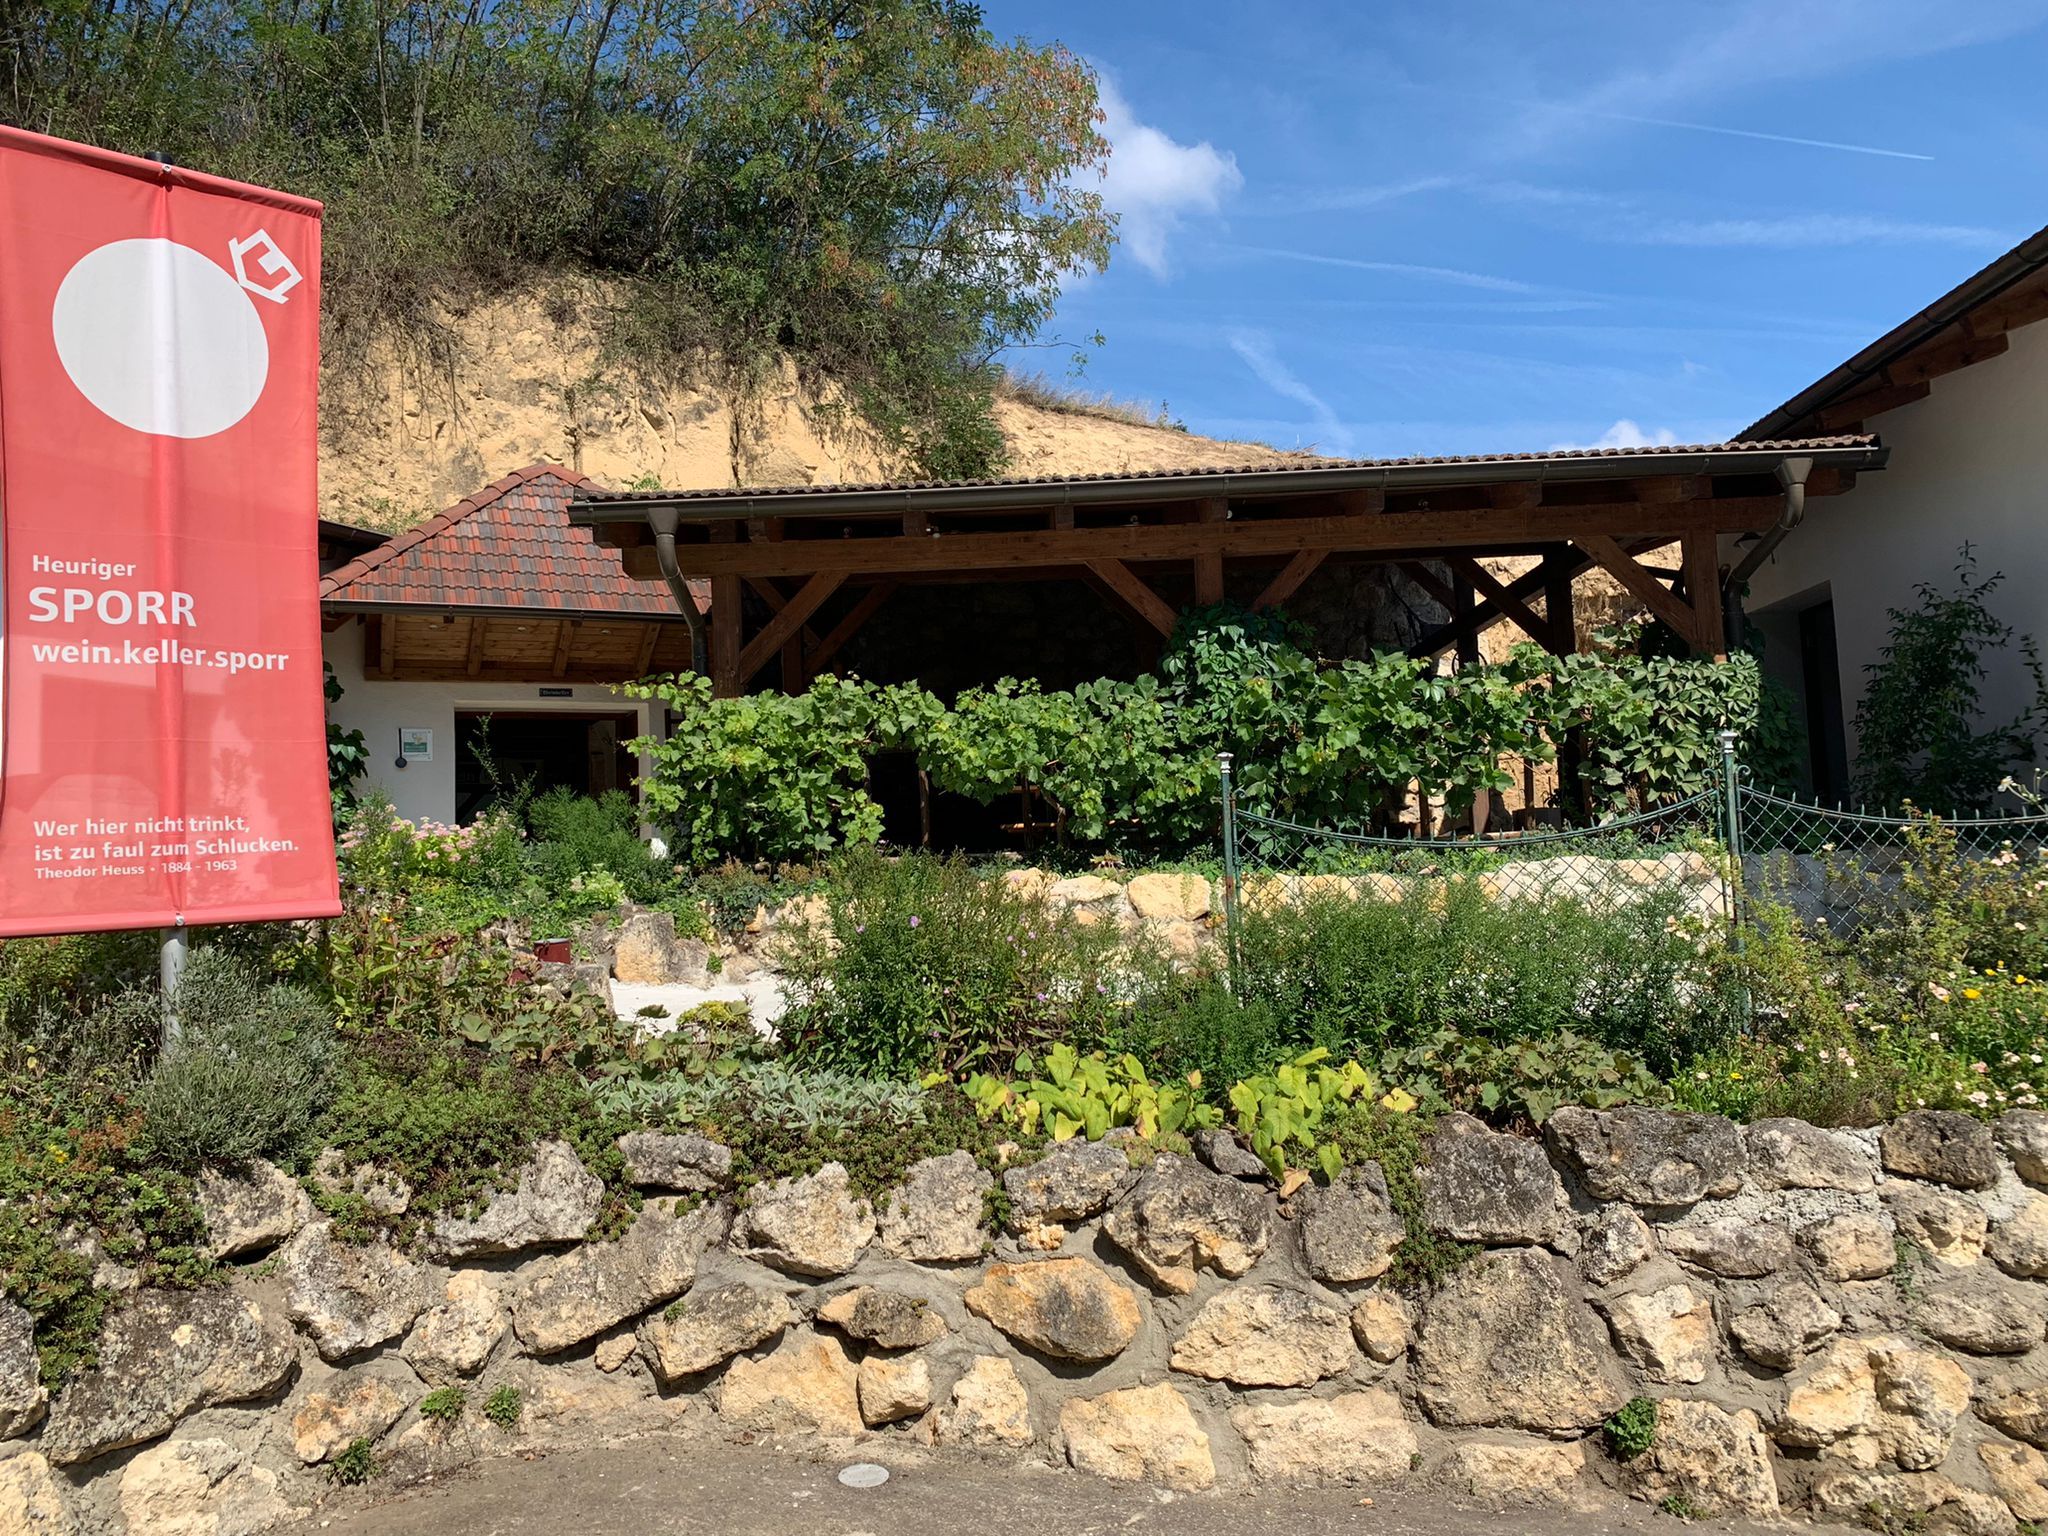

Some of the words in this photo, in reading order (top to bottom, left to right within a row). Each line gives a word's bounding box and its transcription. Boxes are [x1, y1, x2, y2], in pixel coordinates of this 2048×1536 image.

[32, 555, 136, 580] Heuriger
[28, 586, 197, 627] SPORR
[32, 639, 289, 674] wein.keller.sporr
[34, 820, 78, 837] Wer
[86, 819, 128, 835] hier
[135, 816, 184, 833] nicht
[189, 816, 250, 833] trinkt,
[34, 845, 63, 861] ist
[70, 847, 95, 859] zu
[102, 842, 144, 858] faul
[151, 844, 189, 857] zum
[195, 838, 299, 855] Schlucken.
[34, 865, 97, 879] Theodor
[102, 864, 145, 876] Heuss
[161, 862, 192, 873] 1884
[205, 860, 237, 872] 1963
